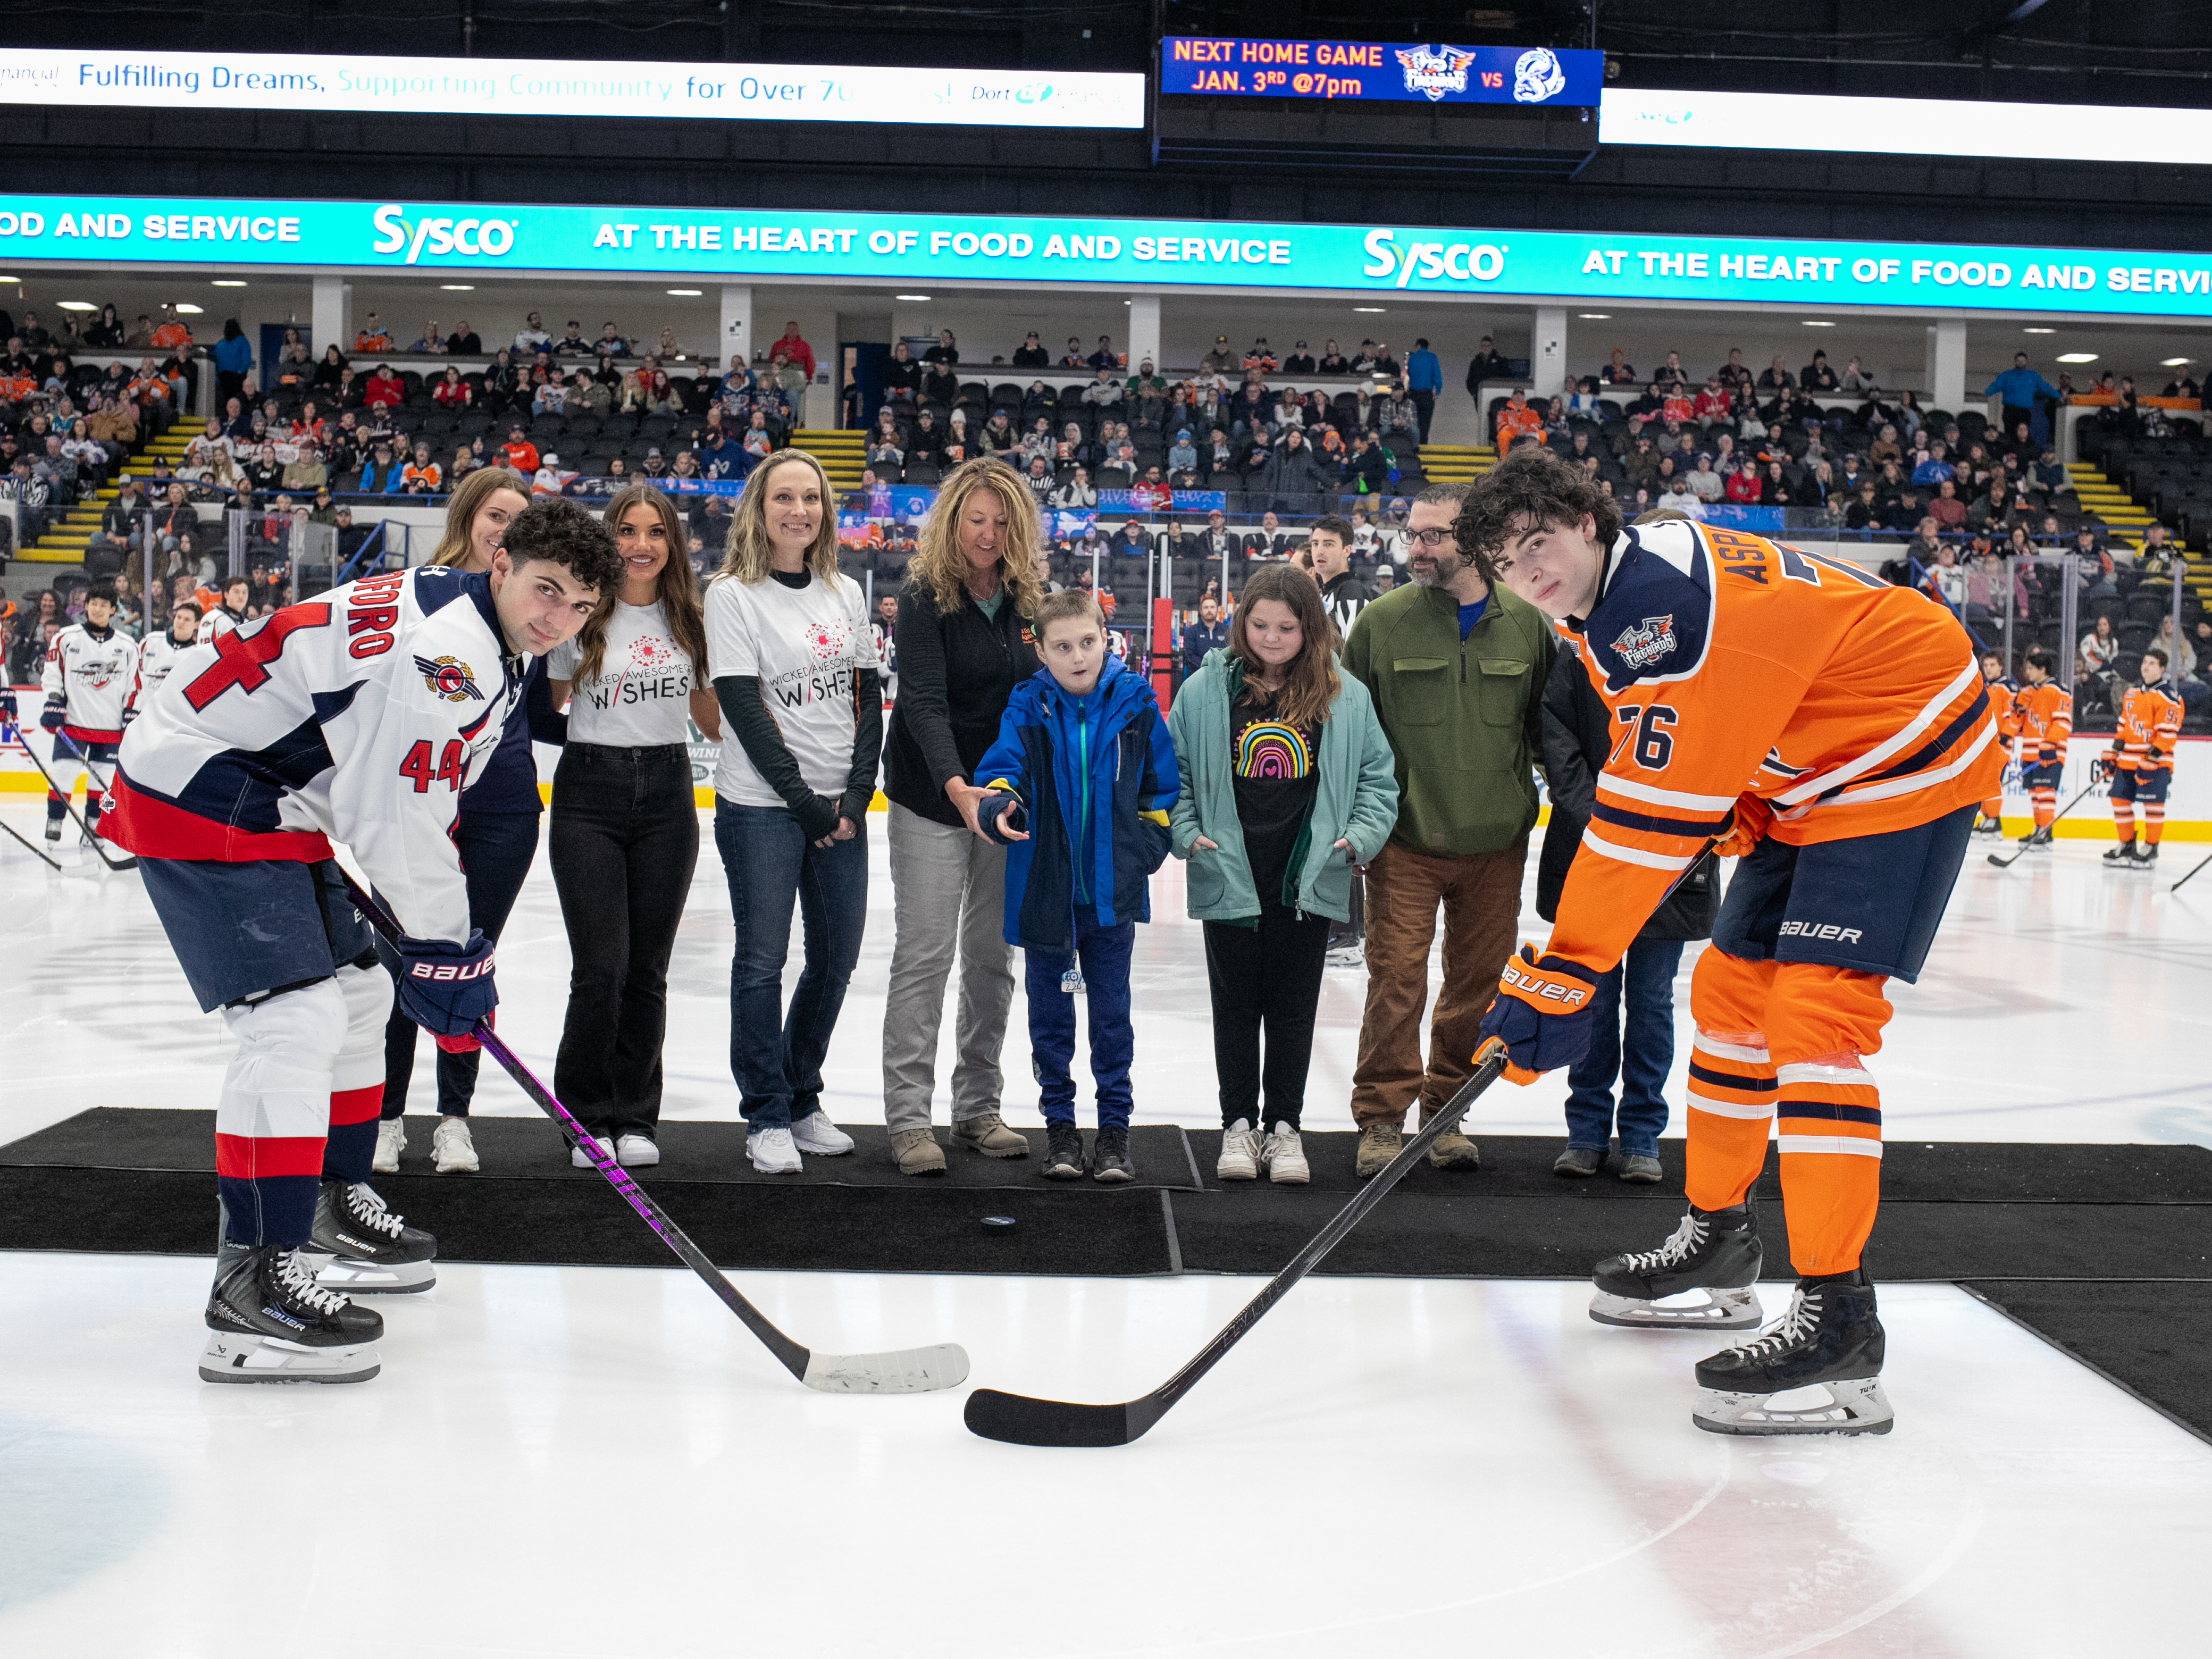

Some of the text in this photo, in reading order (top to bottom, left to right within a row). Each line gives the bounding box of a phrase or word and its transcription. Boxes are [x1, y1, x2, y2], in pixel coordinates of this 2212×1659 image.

[1174, 41, 1384, 67] NEXT HOME GAME
[0, 65, 59, 80] nancial
[80, 64, 200, 95] Fulfilling
[213, 66, 325, 94] Dreams,
[338, 70, 496, 100] Supporting
[509, 74, 673, 102] Community
[686, 77, 727, 99] for
[740, 78, 807, 101] Over
[1191, 70, 1362, 99] JAN. 3RD @7pm
[1481, 72, 1503, 88] VS
[972, 86, 1010, 100] Dort
[54, 214, 132, 238] AND
[143, 215, 300, 242] SERVICE
[373, 205, 514, 264] Sysco
[593, 224, 1291, 264] AT THE HEART OF FOOD AND SERVICE
[1363, 230, 1504, 288] Sysco
[1582, 250, 2212, 294] AT THE HEART OF FOOD AND SERVI
[1623, 632, 1674, 666] FIREBIRDS
[625, 664, 684, 681] AWESOME
[769, 667, 809, 686] WICKED
[1610, 703, 1680, 772] 76
[399, 739, 465, 793] 44
[1778, 921, 1863, 945] BAUER
[411, 951, 495, 981] BAUE
[1501, 963, 1587, 1006] BAUER
[336, 1233, 377, 1253] BAUER
[261, 1306, 307, 1331] BAUER
